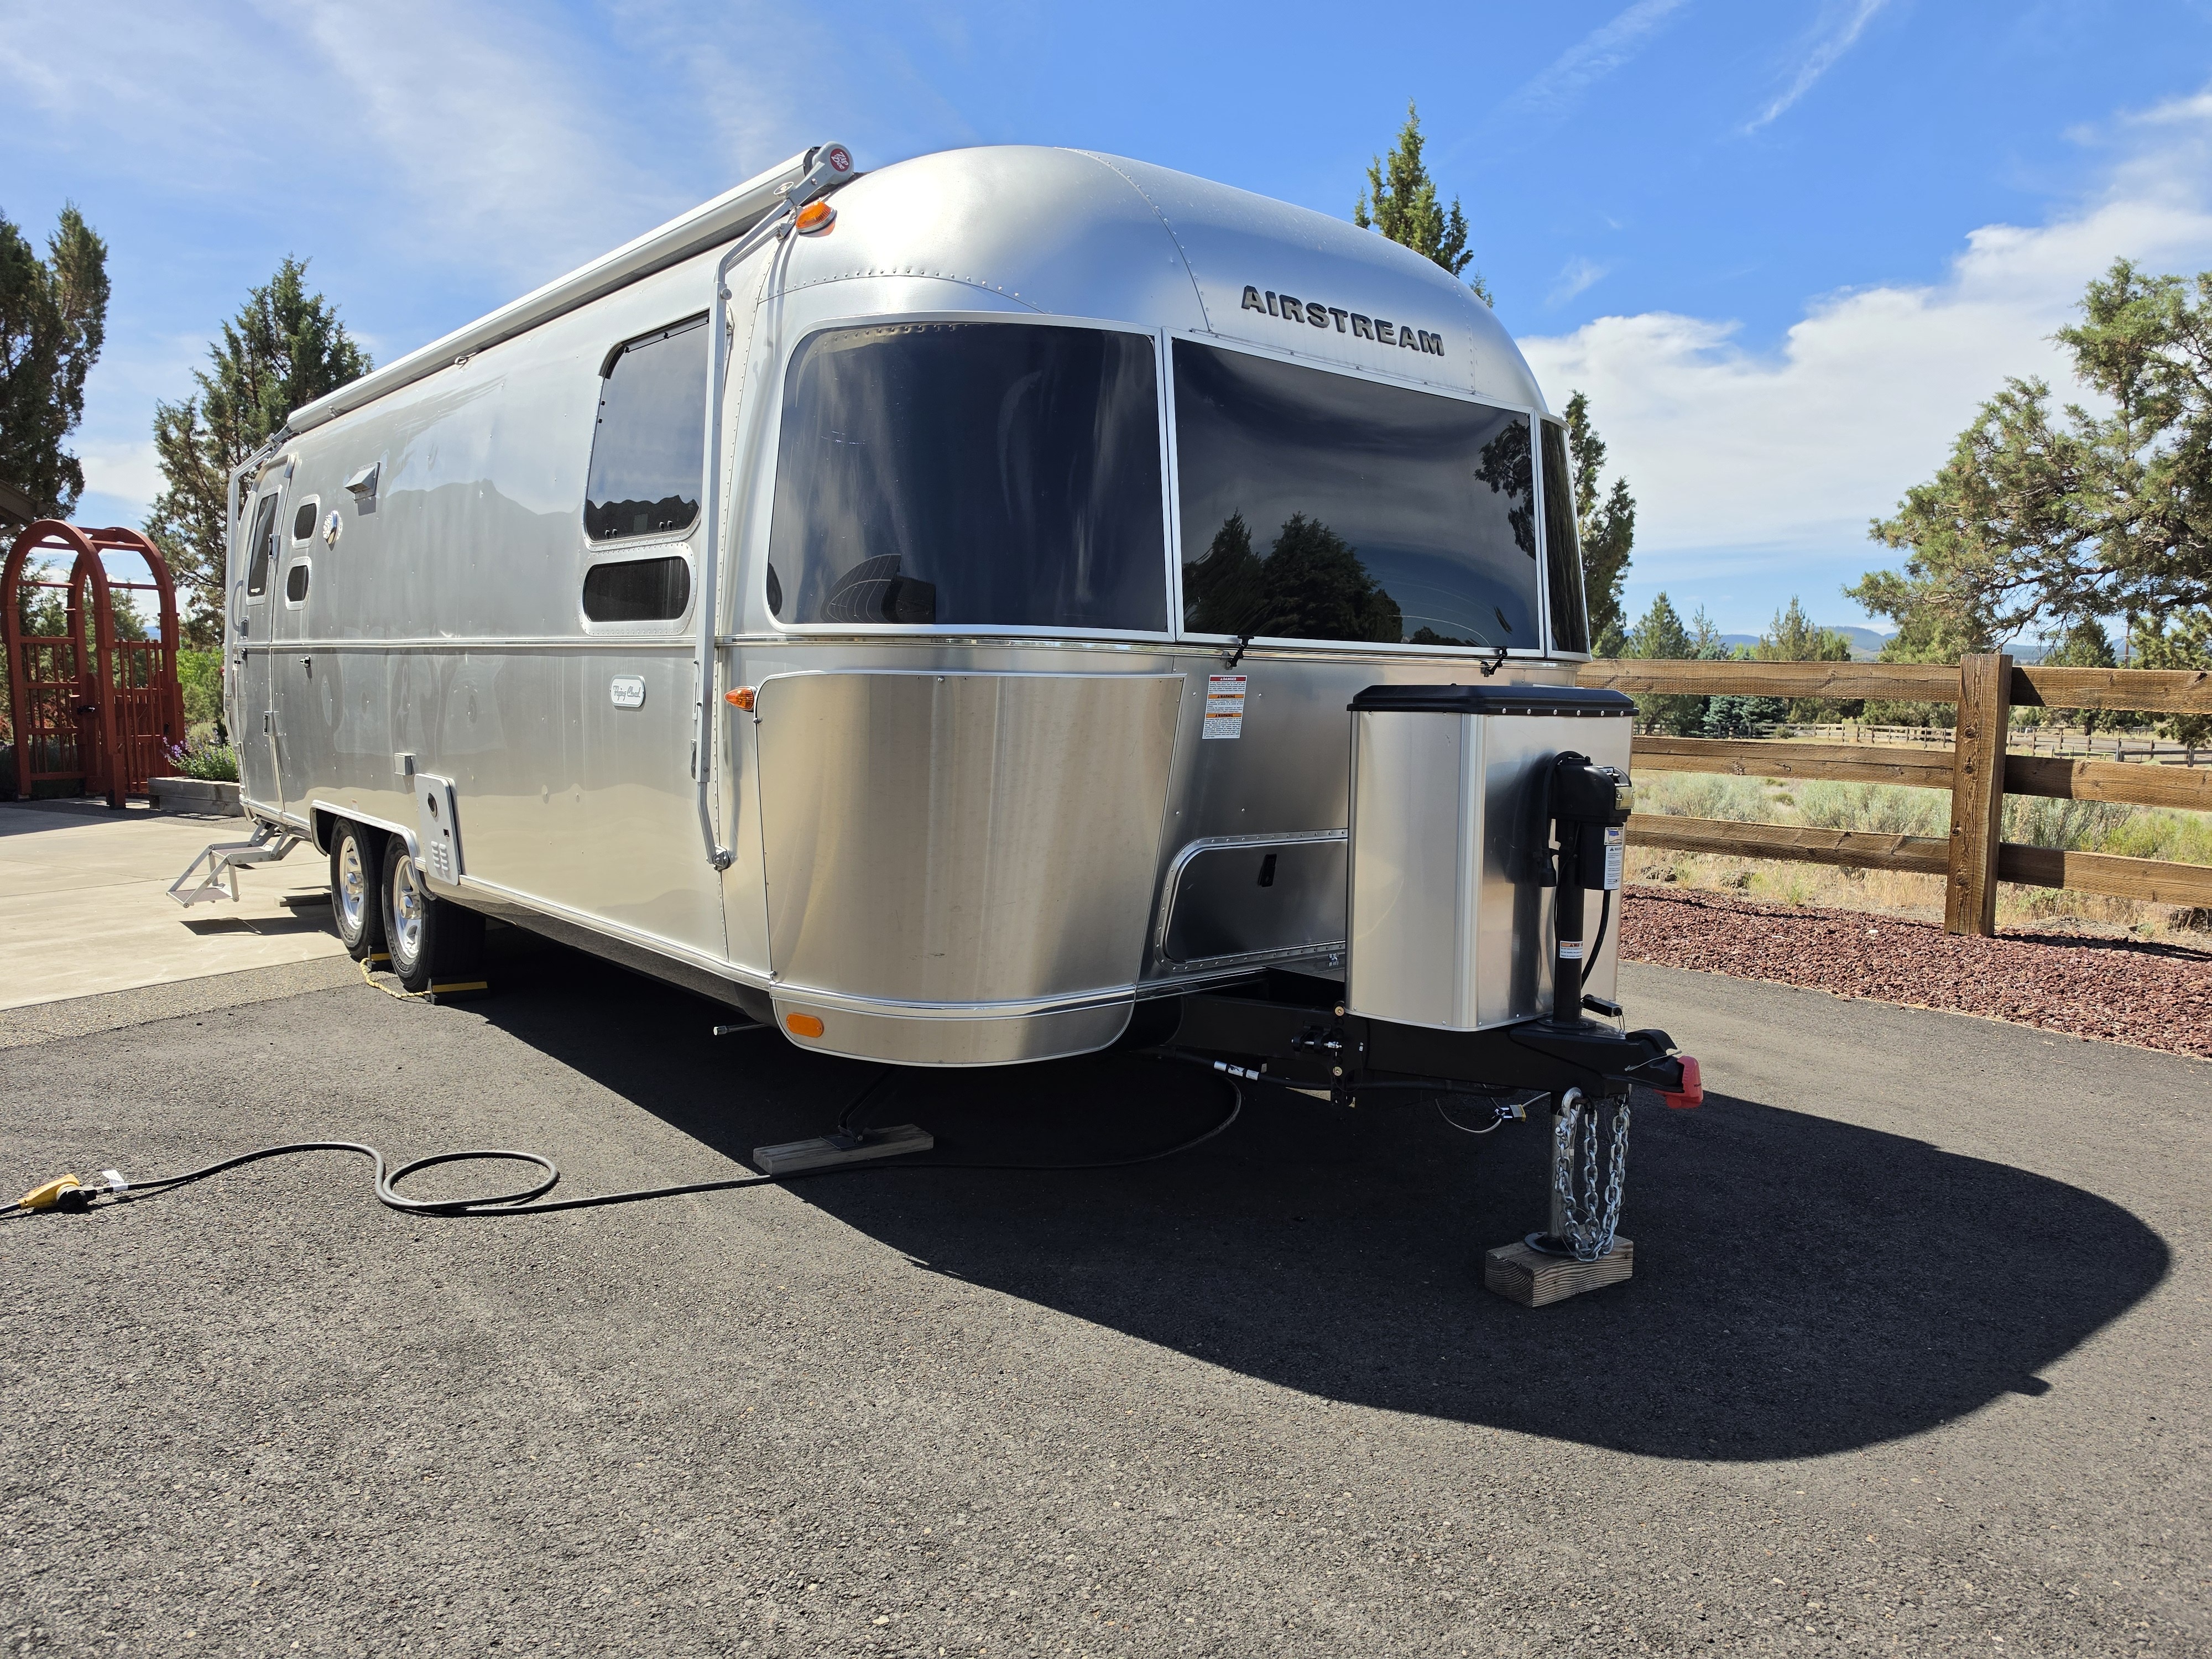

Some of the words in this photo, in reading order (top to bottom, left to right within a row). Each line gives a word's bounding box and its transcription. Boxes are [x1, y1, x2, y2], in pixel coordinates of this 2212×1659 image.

[831, 154, 845, 170] Dee
[836, 152, 849, 166] Zip
[1241, 285, 1445, 357] AIRSTREAM
[627, 685, 641, 698] Cloud
